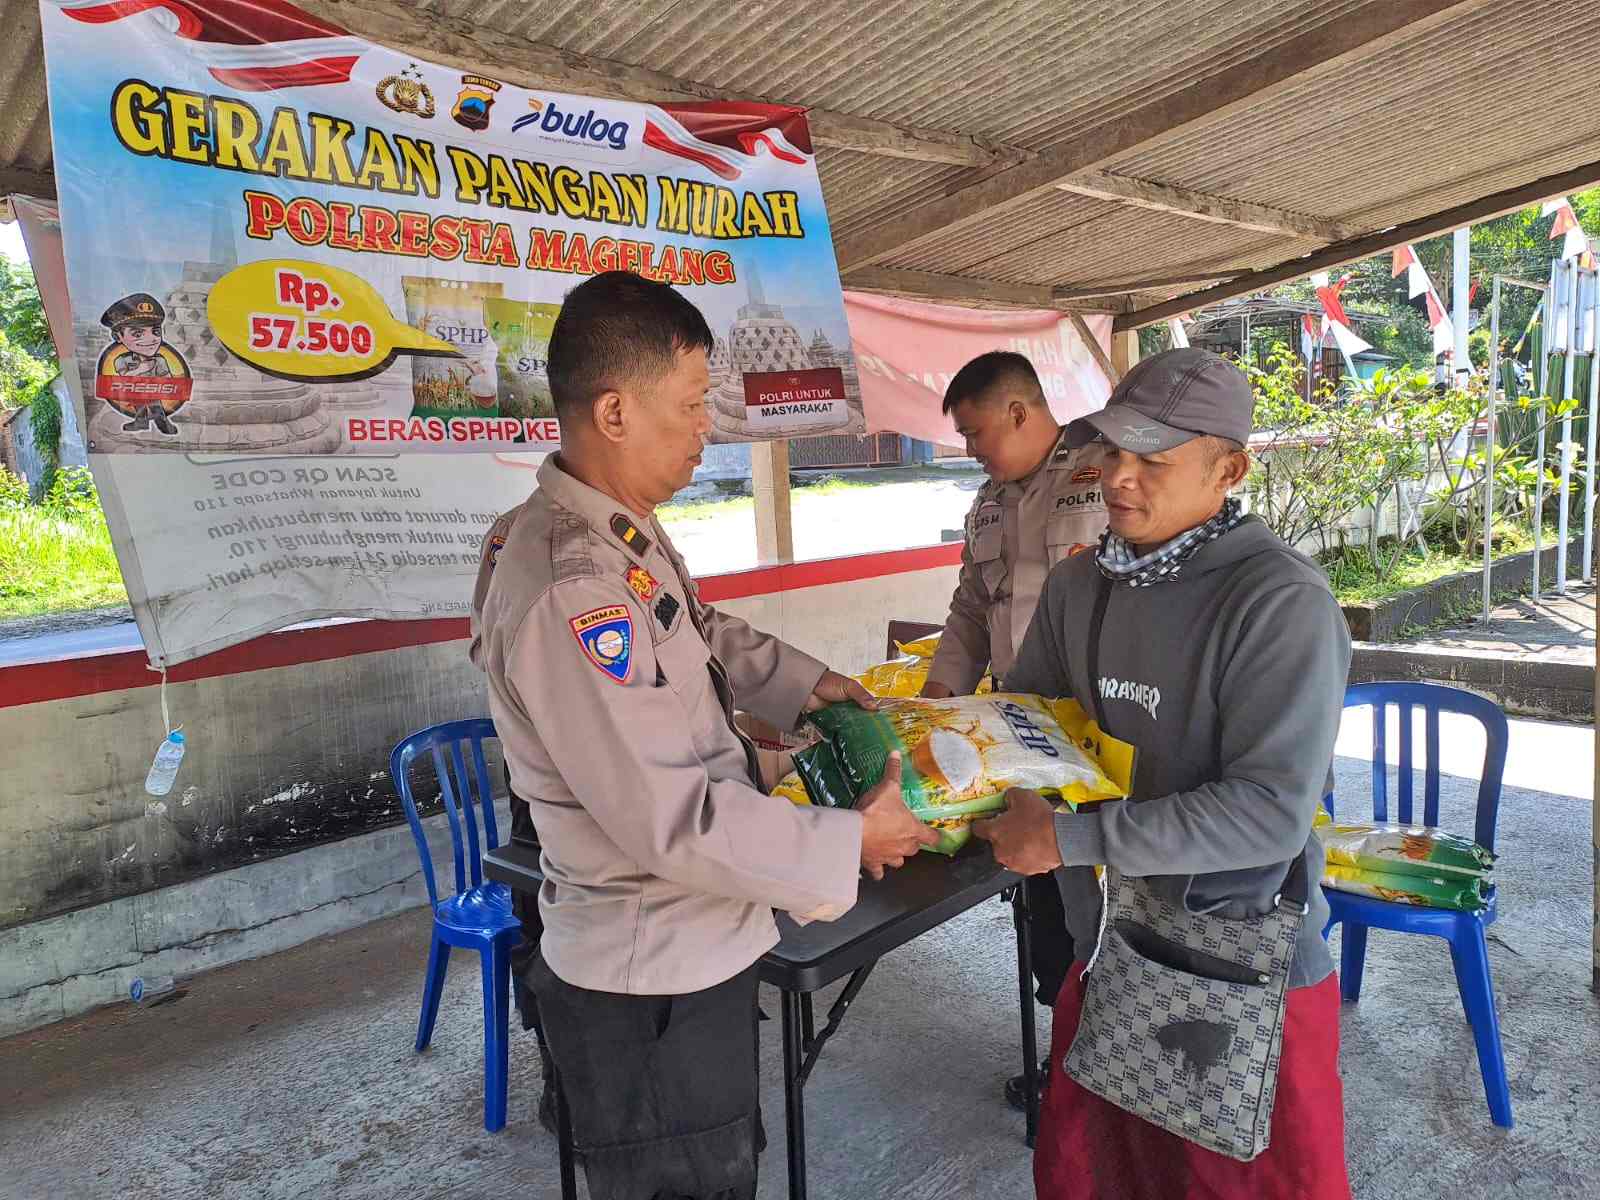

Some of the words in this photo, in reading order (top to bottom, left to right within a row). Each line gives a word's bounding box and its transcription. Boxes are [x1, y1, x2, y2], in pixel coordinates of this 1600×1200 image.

[540, 103, 629, 150] bulog
[111, 78, 441, 198] GERAKAN
[446, 146, 648, 228] PANGAN
[657, 175, 804, 240] MURAH
[244, 190, 519, 267] POLRESTA
[527, 227, 736, 285] MAGELANG
[278, 272, 340, 311] Rp.
[252, 317, 371, 354] 57.500
[435, 326, 489, 344] SPHP
[518, 357, 548, 372] SP
[111, 382, 178, 394] PRESISI
[760, 391, 793, 403] POLRI
[796, 388, 832, 400] UNTUK
[761, 402, 833, 417] MASYARAKAT
[349, 418, 444, 442] BERAS
[451, 420, 519, 442] SPHP
[526, 420, 560, 441] KE
[1056, 491, 1101, 509] POLRI
[580, 608, 622, 625] BINMAS
[1098, 677, 1161, 720] HRASHER
[994, 700, 1060, 757] SPHP
